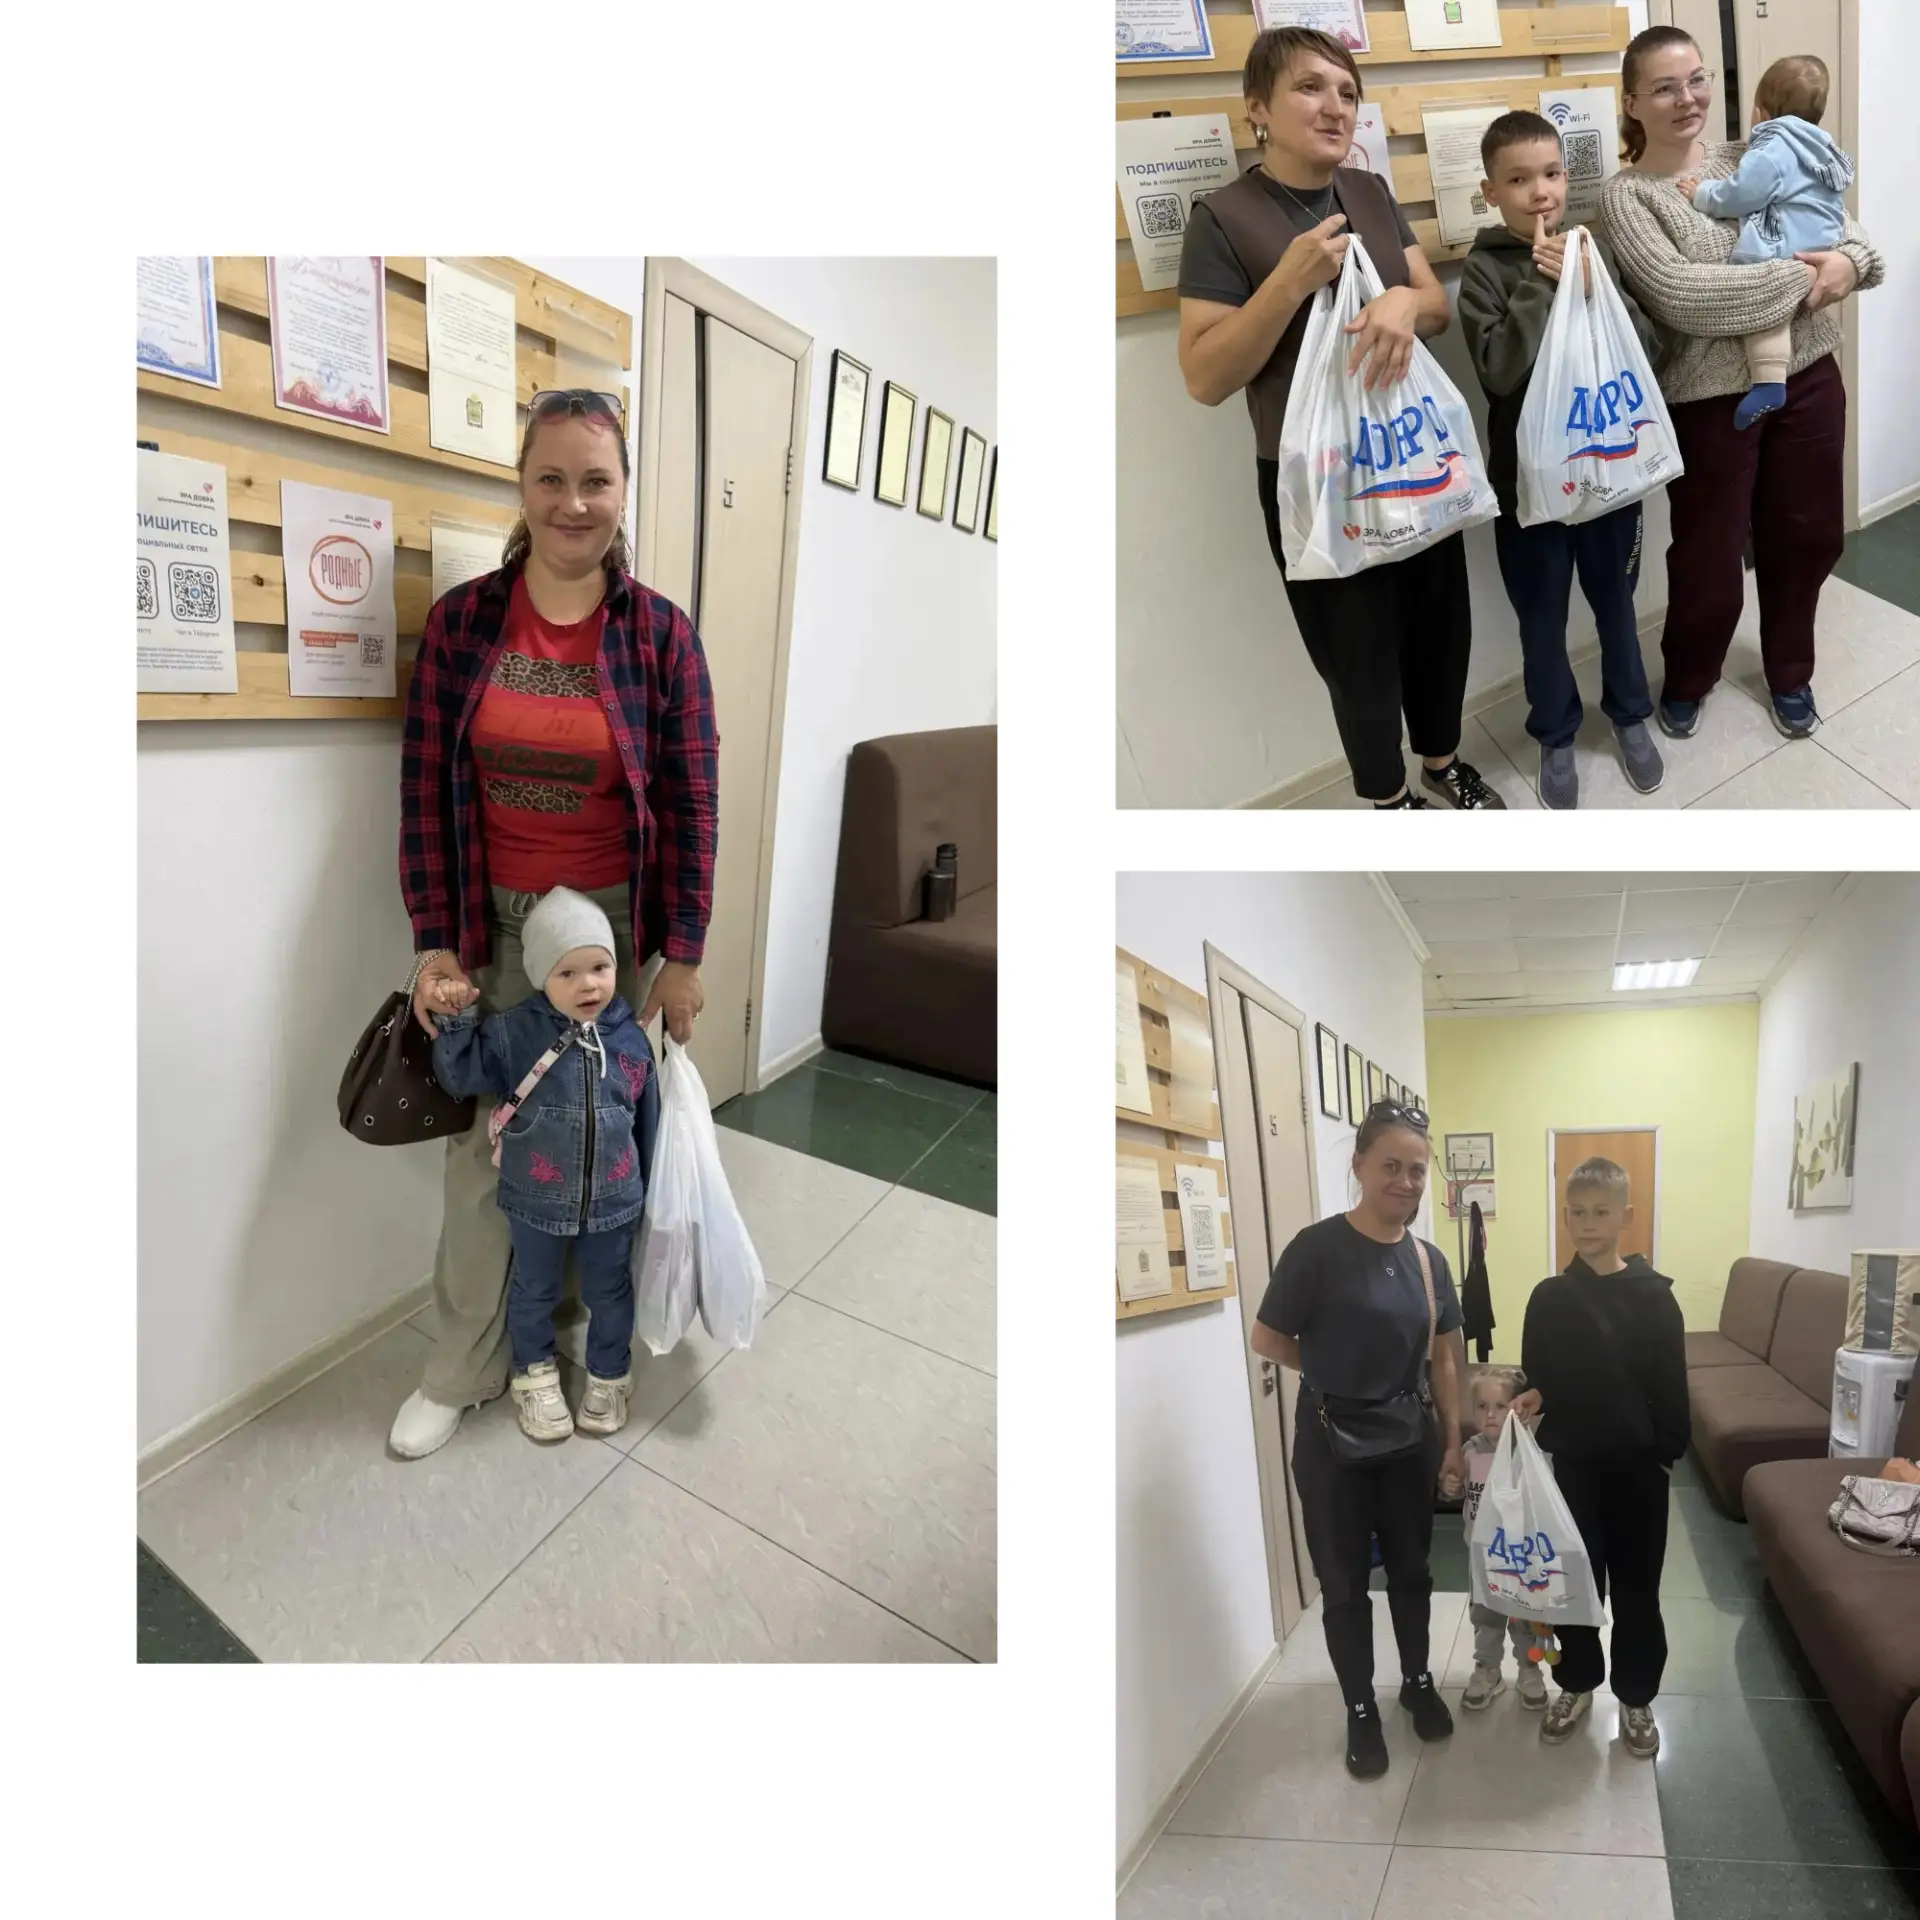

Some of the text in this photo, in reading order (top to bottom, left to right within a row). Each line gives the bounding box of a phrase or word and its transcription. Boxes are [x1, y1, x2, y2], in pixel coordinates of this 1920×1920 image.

[1569, 113, 1591, 123] Wi-Fi
[1126, 157, 1228, 175] ПОДПИШИТЕСЬ
[1159, 176, 1202, 186] социальных
[1202, 174, 1222, 182] сетях
[1363, 524, 1416, 540] ЭРА ДОБРА
[1634, 514, 1642, 544] FUTURE
[186, 543, 208, 553] сетях
[1630, 542, 1641, 557] THE
[321, 552, 363, 591] РОДНЫЕ
